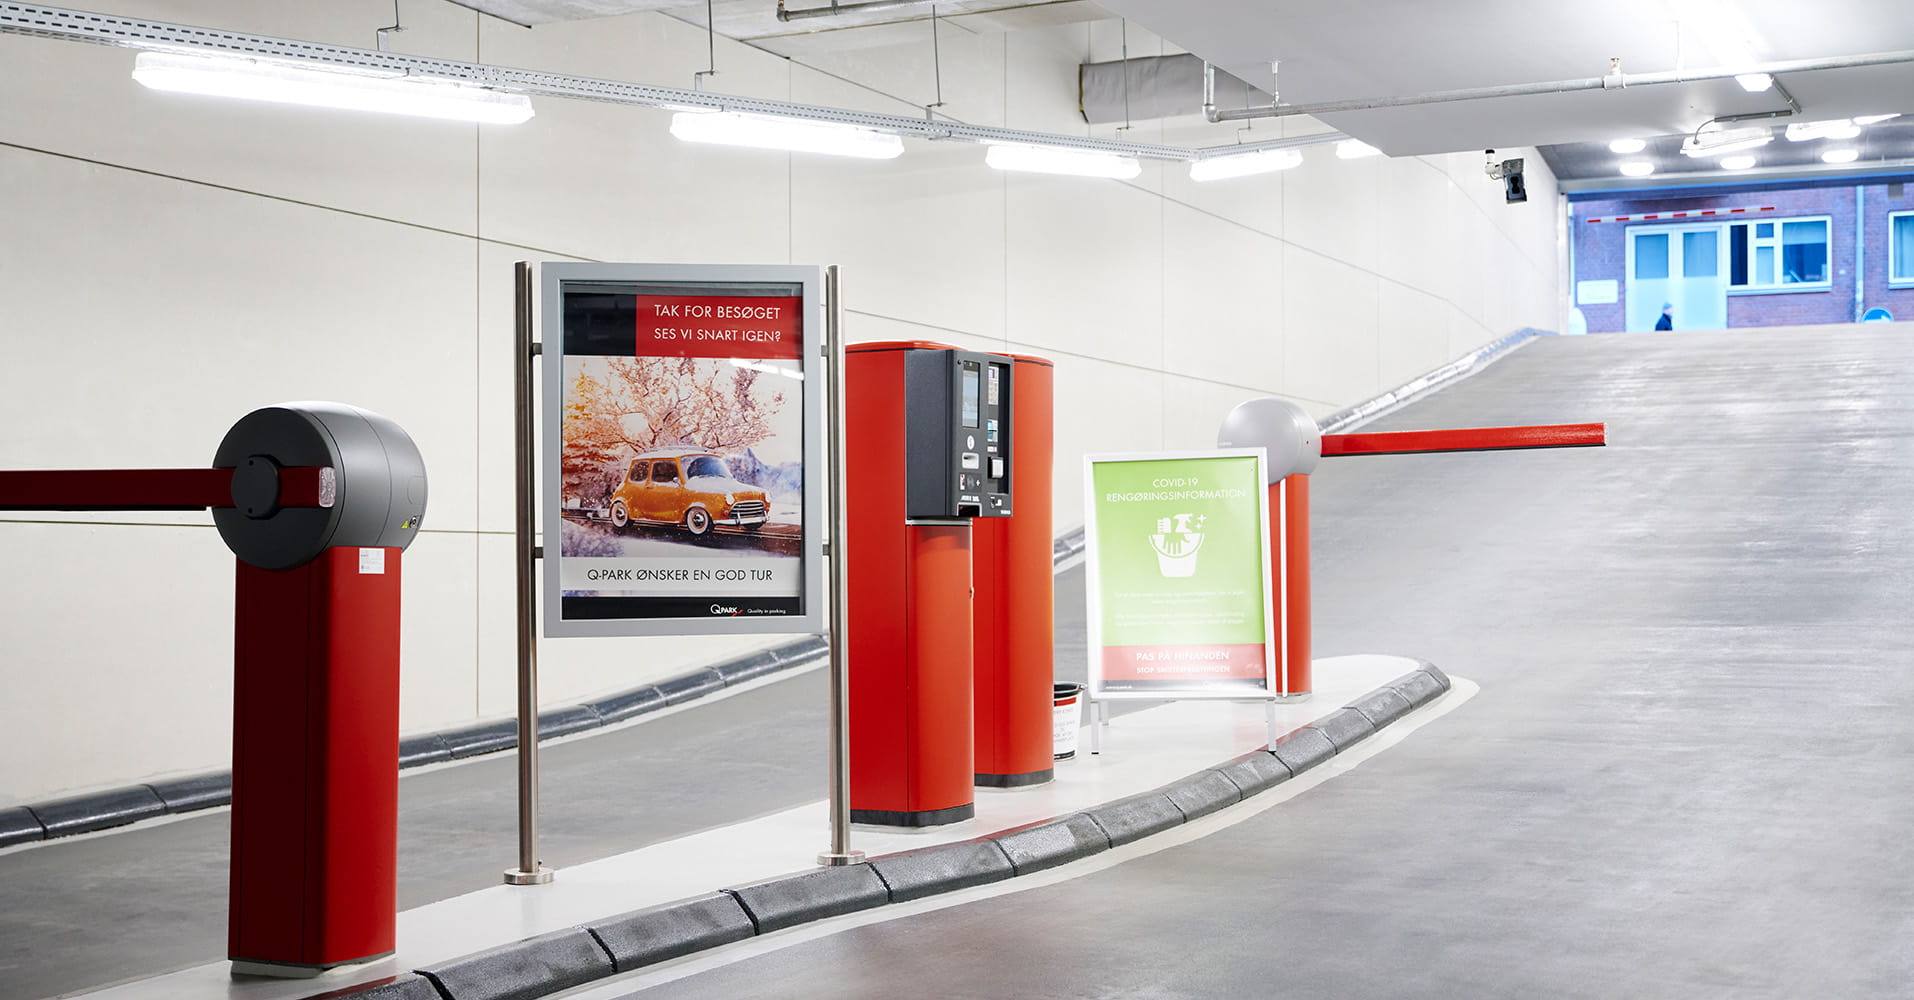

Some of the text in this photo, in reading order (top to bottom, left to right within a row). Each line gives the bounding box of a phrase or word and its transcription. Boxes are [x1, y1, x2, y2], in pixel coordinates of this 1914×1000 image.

[654, 304, 781, 320] TAK FOR BESØGET
[654, 328, 782, 342] SES VI SNART IGEN?
[1152, 477, 1199, 488] COVID-19
[587, 568, 773, 581] Q-PARK ØNSKER EN GOD TUR
[1136, 652, 1154, 662] PAS
